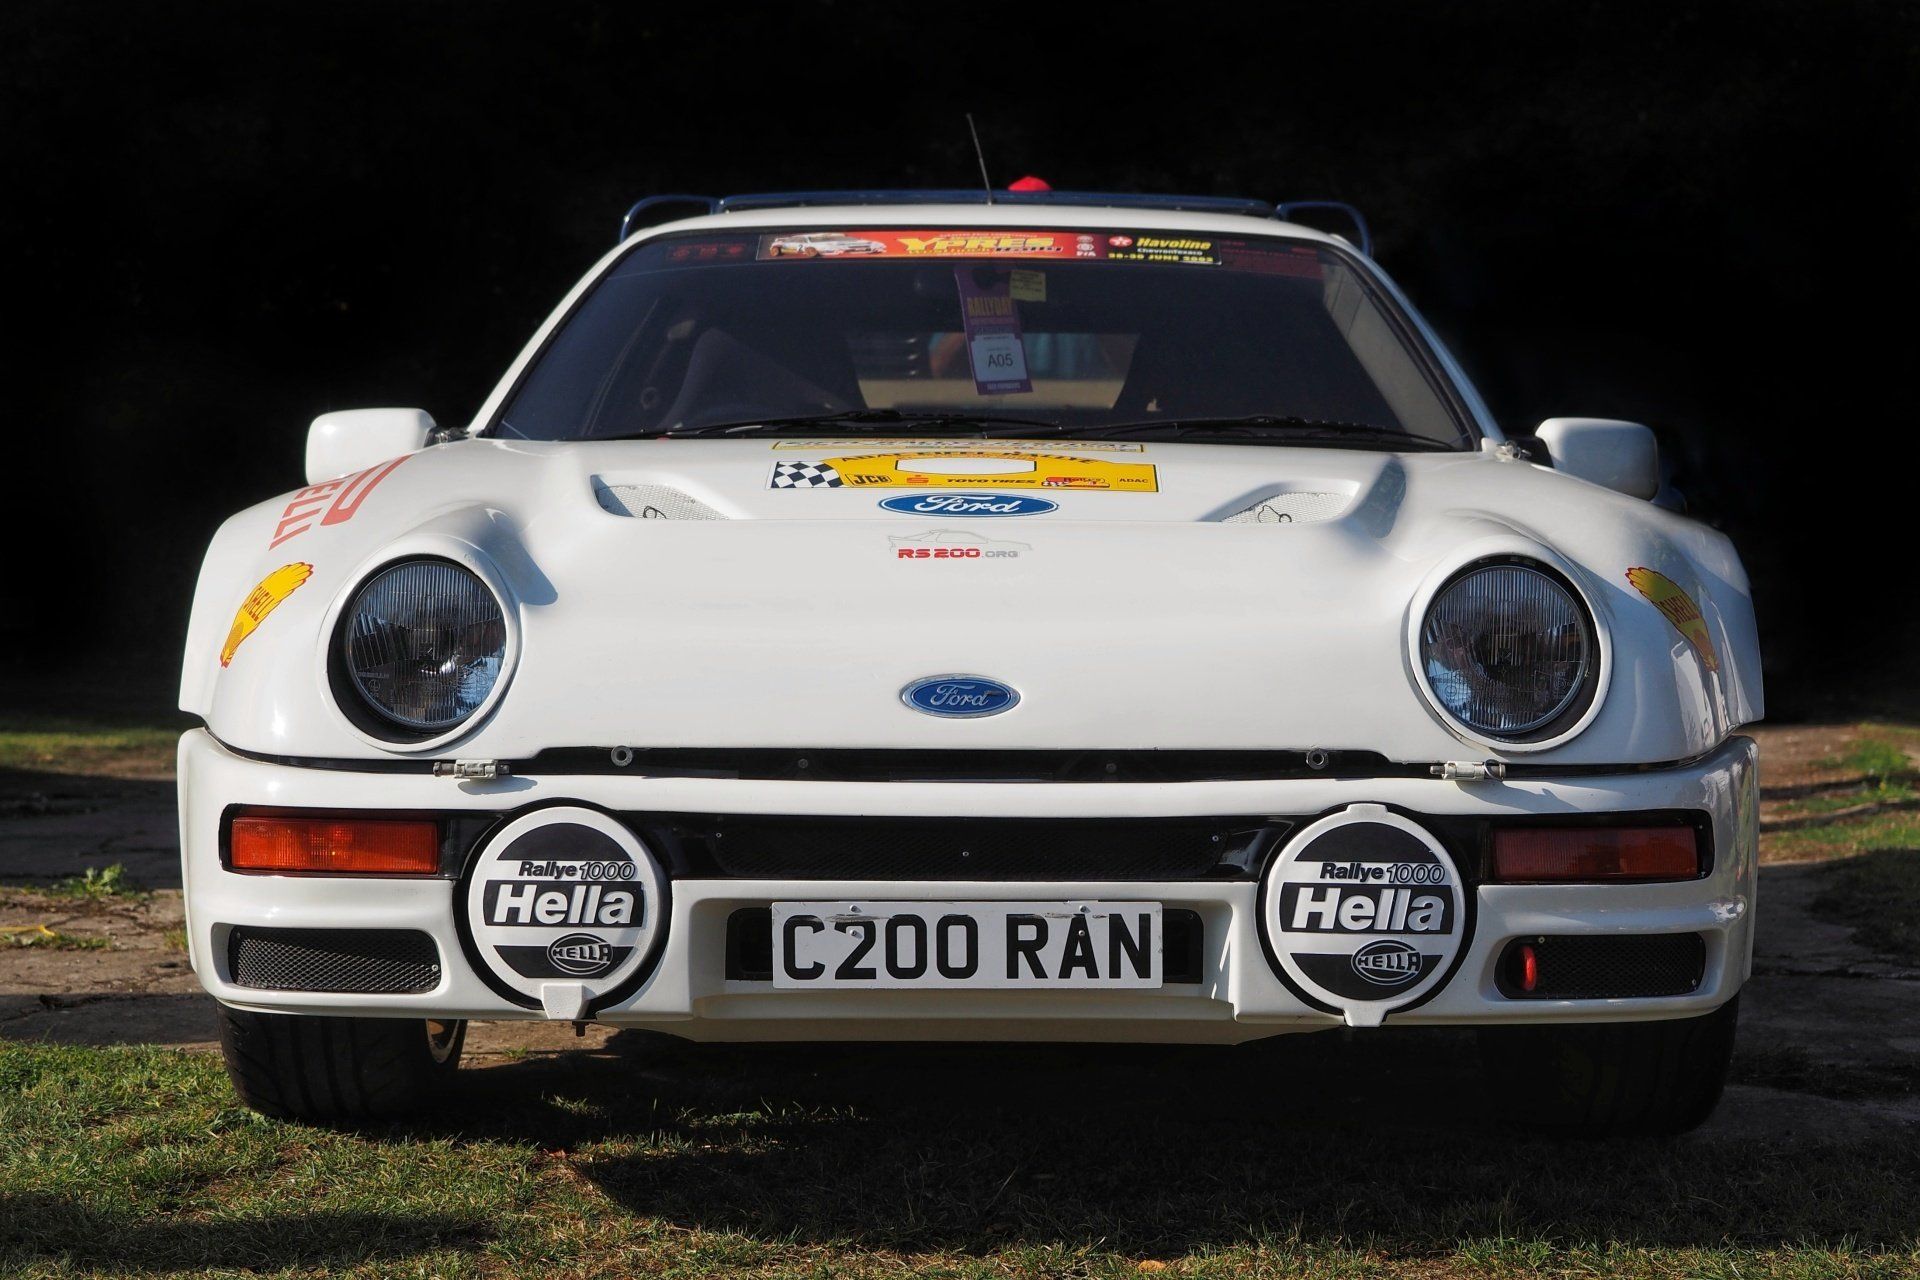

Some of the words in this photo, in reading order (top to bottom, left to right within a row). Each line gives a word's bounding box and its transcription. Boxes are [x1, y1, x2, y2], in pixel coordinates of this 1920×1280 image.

[896, 237, 1054, 251] YPRES
[1136, 237, 1212, 250] Havoline
[988, 353, 1014, 368] A05
[853, 474, 889, 485] JCB
[914, 494, 1022, 513] Ford
[930, 684, 989, 706] Ford
[519, 861, 577, 880] Rallye
[579, 861, 636, 881] 1000
[1320, 862, 1384, 882] Rallye
[1386, 863, 1446, 883] 1000
[493, 884, 635, 925] Hella
[1291, 887, 1445, 931] Hella
[552, 943, 612, 963] HELLA
[783, 913, 979, 981] C200
[1006, 913, 1151, 980] RAN
[1357, 951, 1422, 972] HELLA
